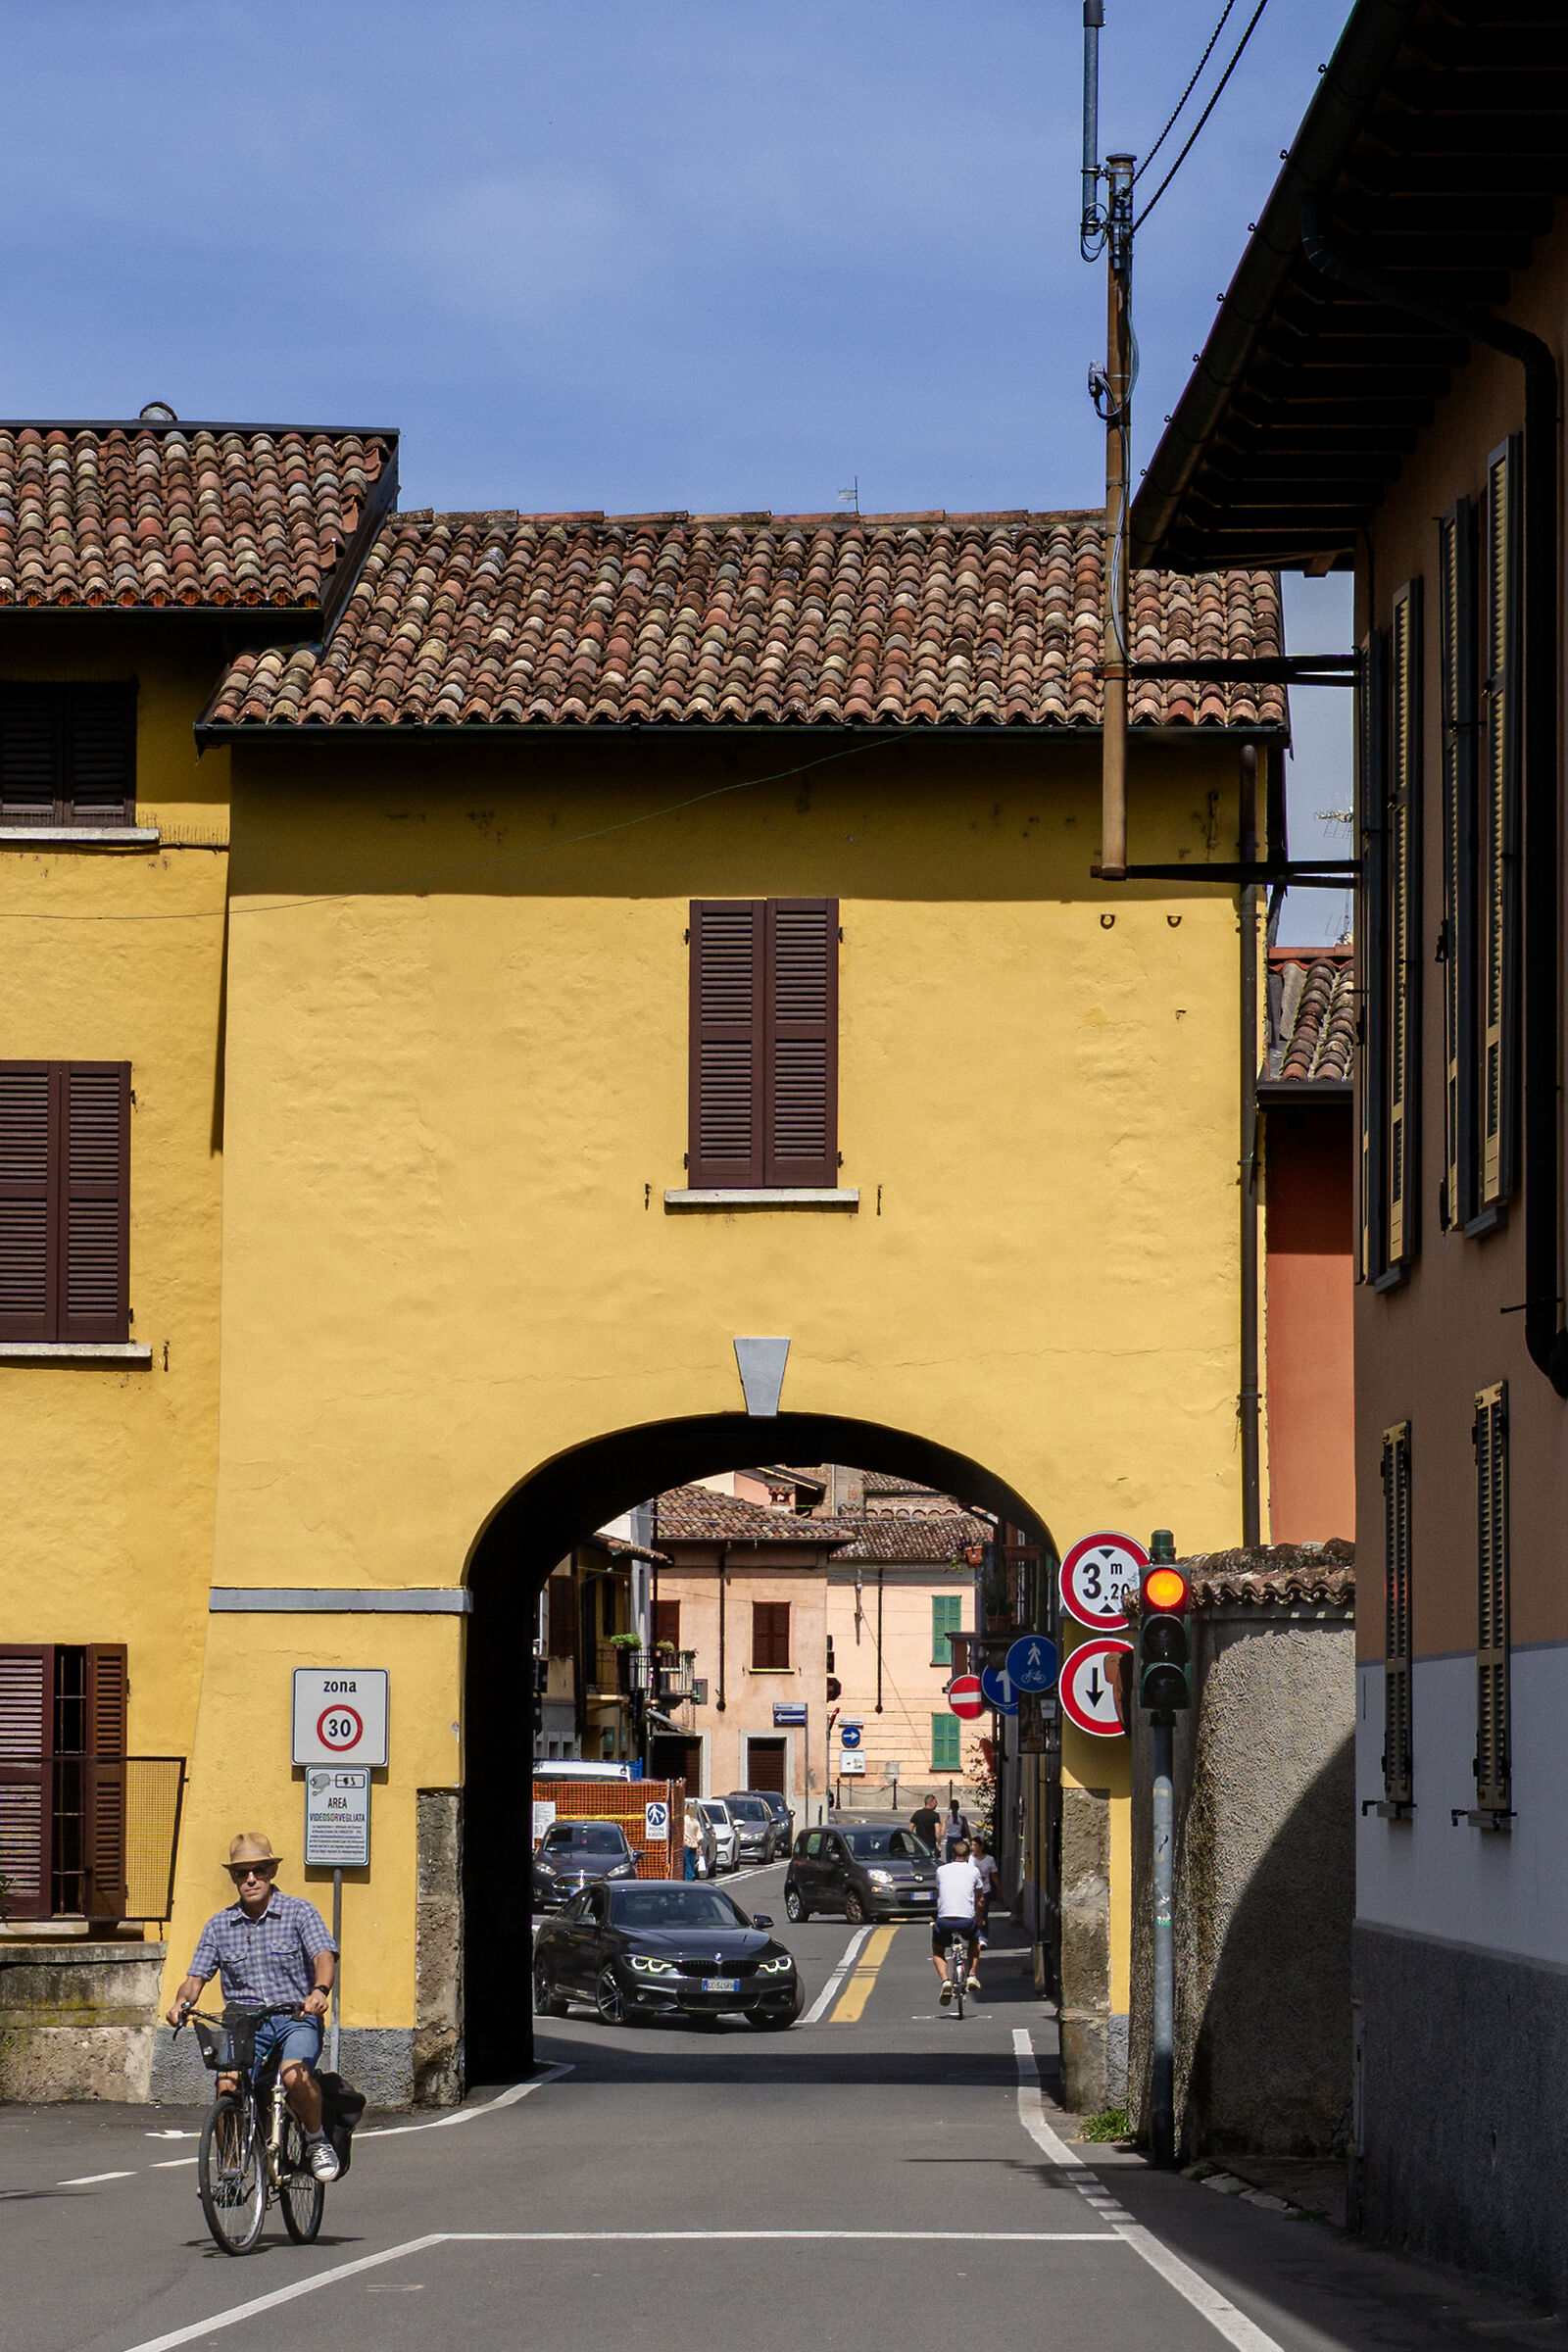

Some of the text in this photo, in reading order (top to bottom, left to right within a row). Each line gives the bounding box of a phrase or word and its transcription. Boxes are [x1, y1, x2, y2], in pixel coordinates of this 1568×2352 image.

[1110, 1563, 1122, 1575] m
[323, 1681, 357, 1693] zona
[328, 1719, 352, 1738] 30
[327, 1797, 348, 1809] AREA
[310, 1813, 366, 1822] VIDEOSORVEGLIATA
